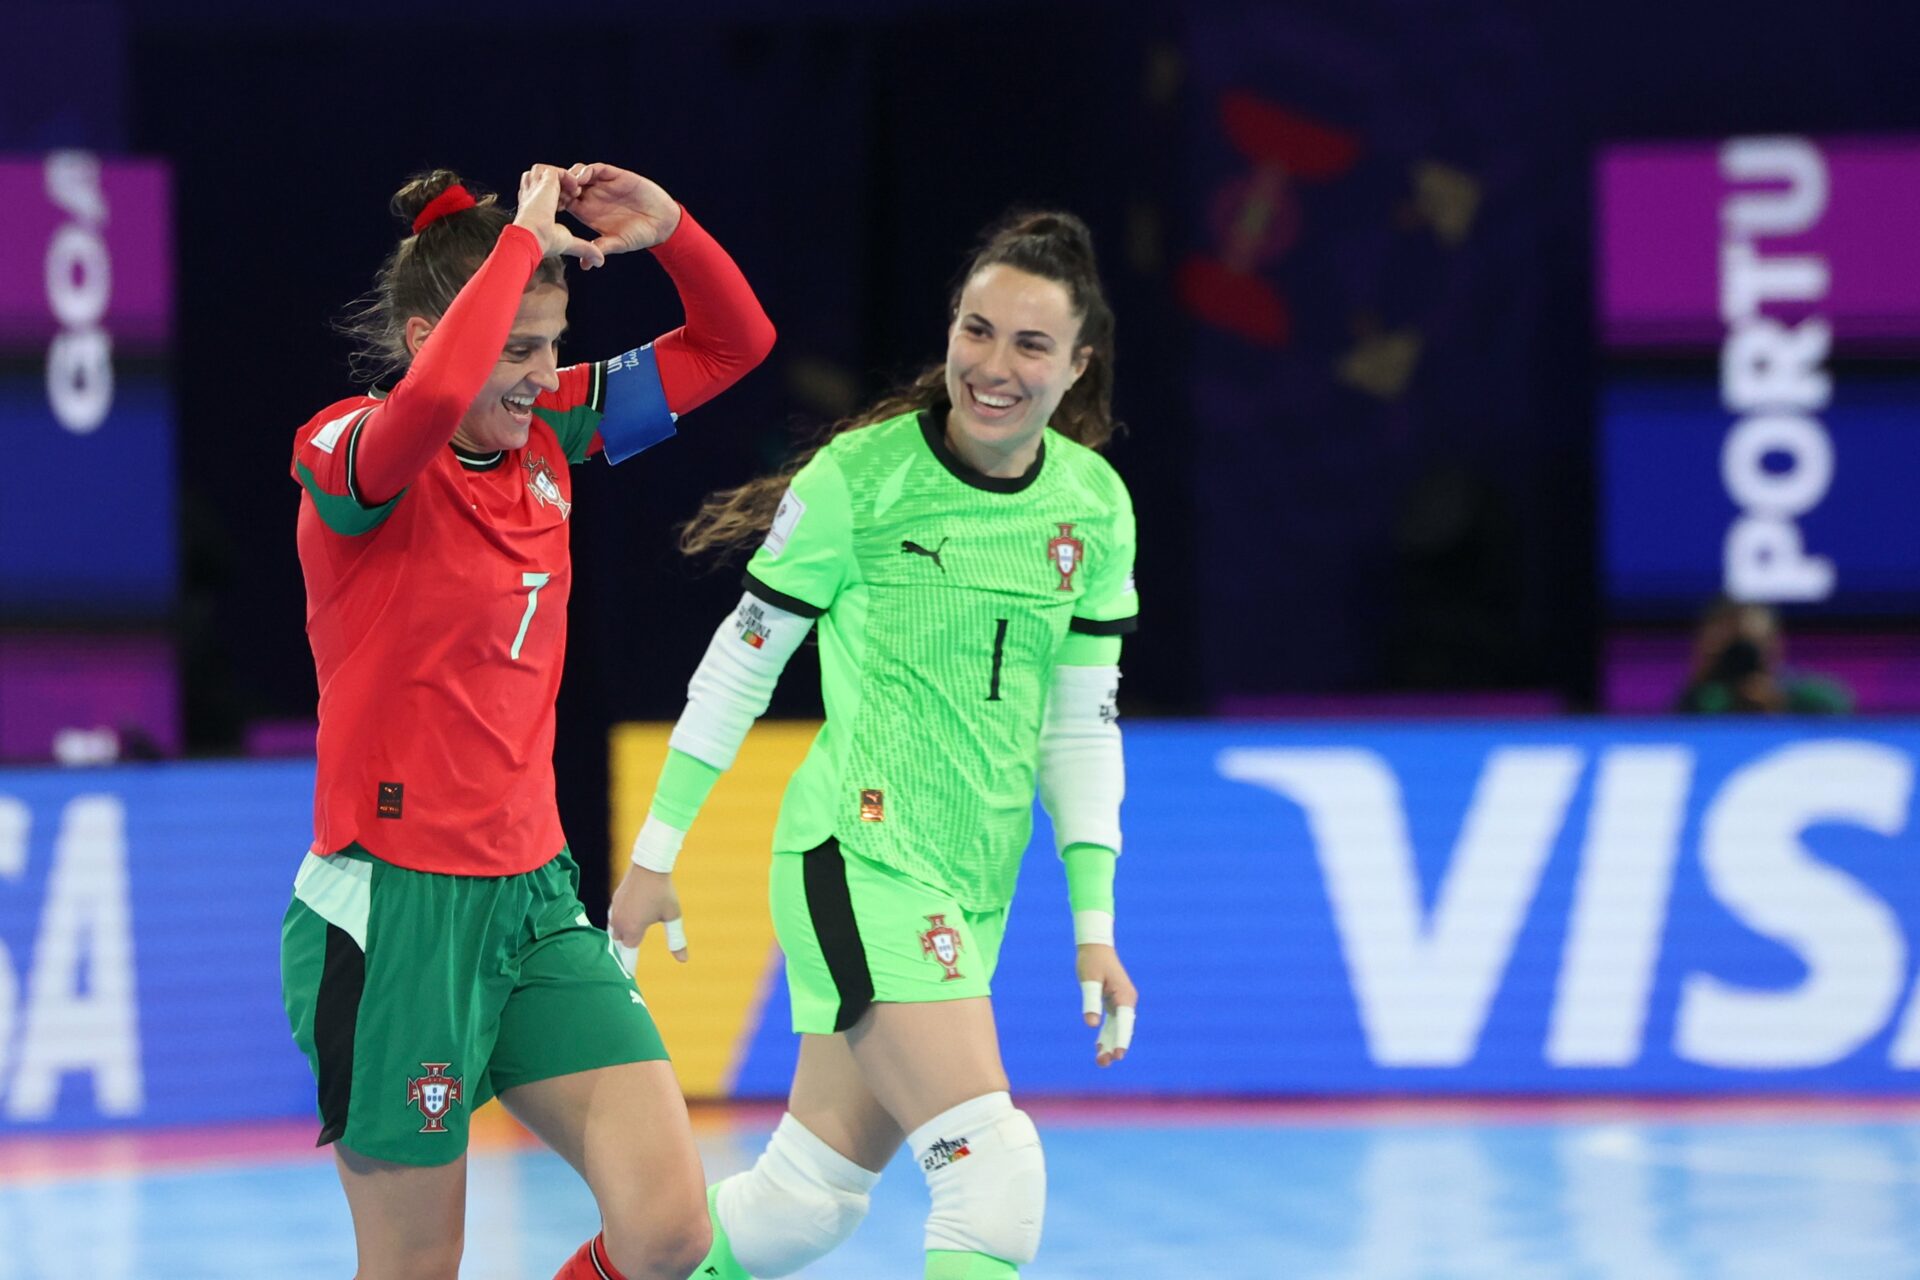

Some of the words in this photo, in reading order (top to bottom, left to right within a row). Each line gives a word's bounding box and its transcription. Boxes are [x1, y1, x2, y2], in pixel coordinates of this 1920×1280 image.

[1720, 135, 1835, 602] PORTU
[511, 573, 550, 660] 7
[986, 618, 1008, 702] 1
[1215, 739, 1920, 1071] VIS
